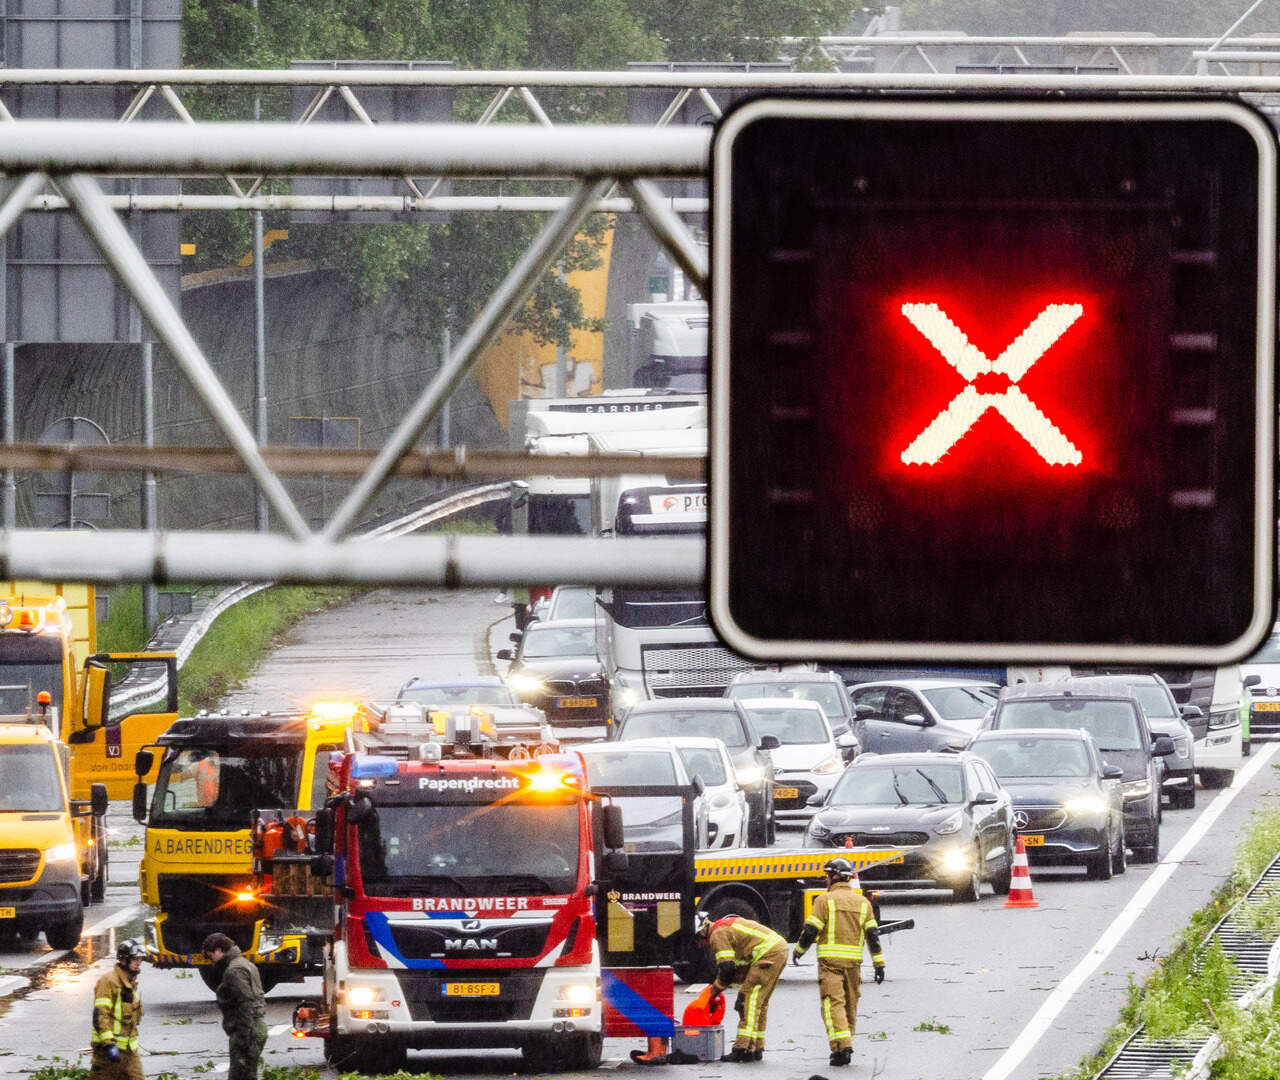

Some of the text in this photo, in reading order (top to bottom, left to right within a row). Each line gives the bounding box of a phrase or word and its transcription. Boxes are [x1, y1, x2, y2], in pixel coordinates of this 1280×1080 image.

[418, 776, 520, 793] Papendrecht
[622, 892, 681, 901] BRANDWEER
[412, 897, 529, 911] BRANDWEER
[444, 938, 498, 951] MAN
[453, 984, 497, 994] 81-BSF-2
